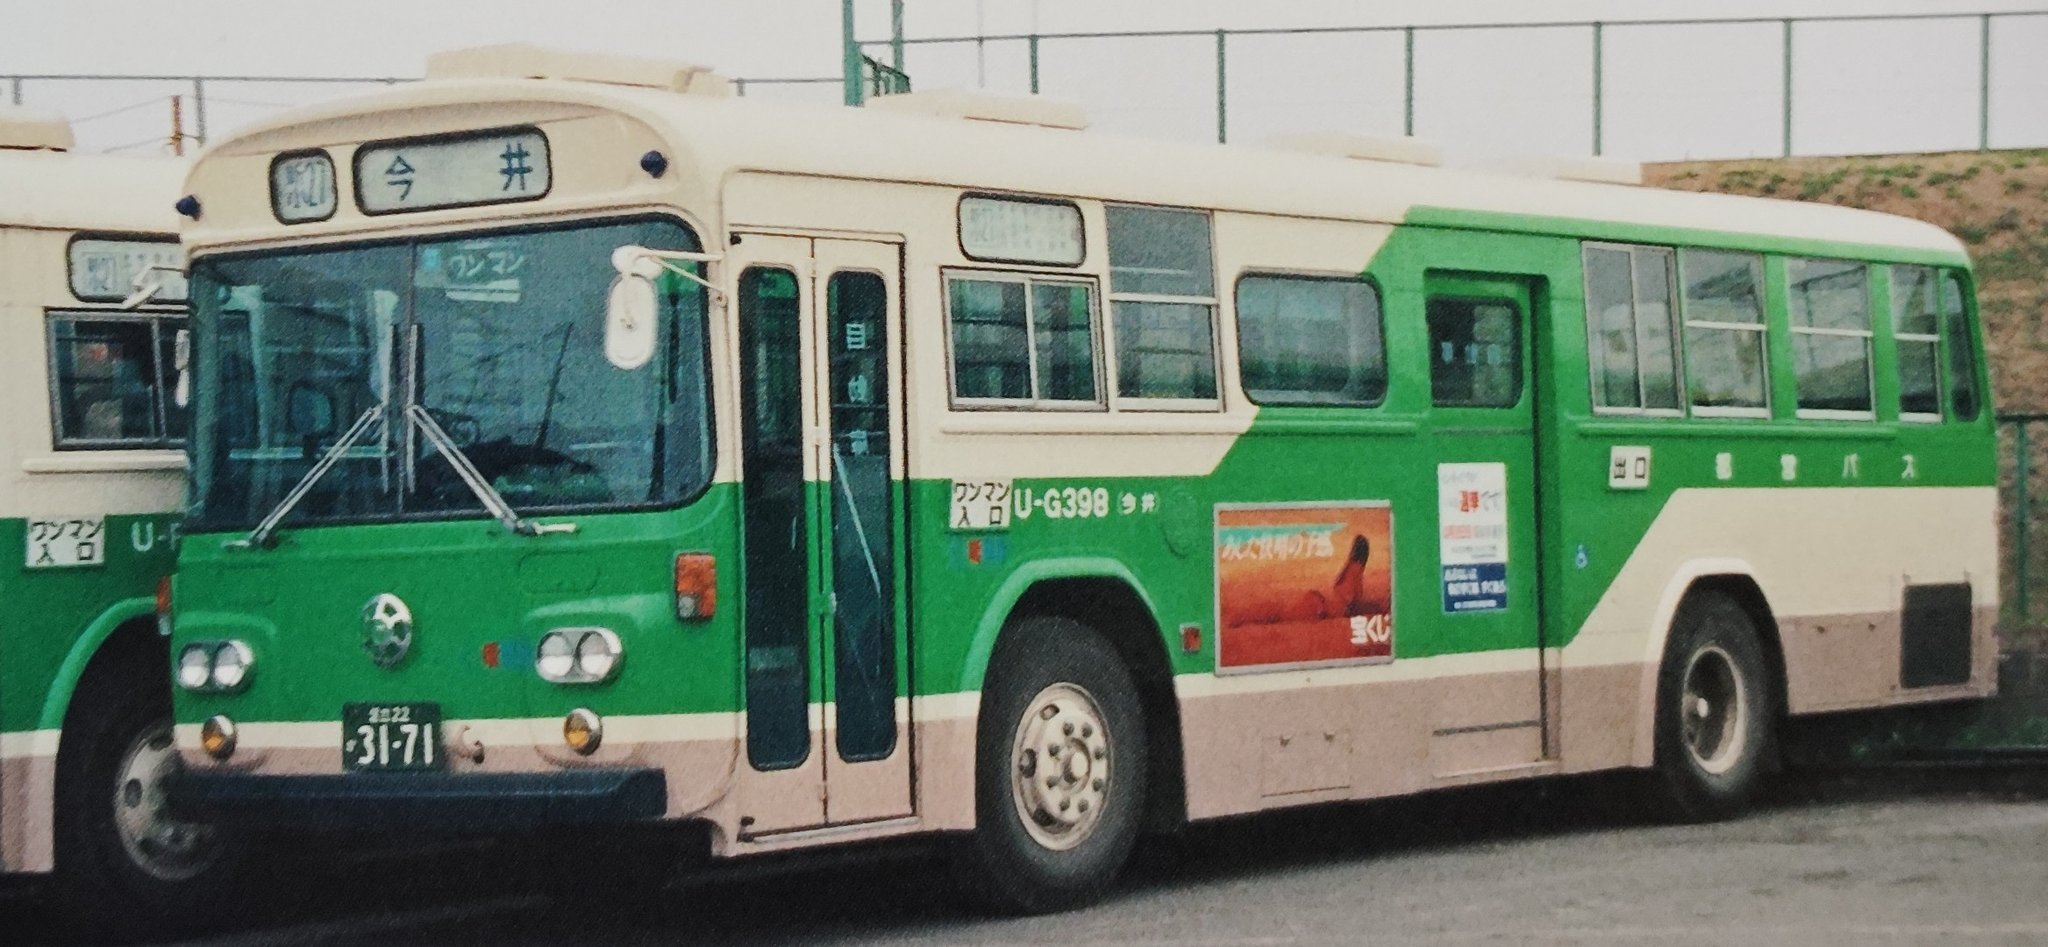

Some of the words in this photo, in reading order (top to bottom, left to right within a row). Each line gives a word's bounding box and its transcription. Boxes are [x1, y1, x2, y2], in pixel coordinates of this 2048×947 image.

[384, 142, 533, 201] 今井
[1613, 456, 1647, 479] 出口
[955, 482, 1010, 502] ワンマン
[1014, 486, 1109, 520] U-G398
[957, 506, 1003, 527] 入口
[31, 519, 104, 542] ワンマン
[36, 542, 95, 564] 入口
